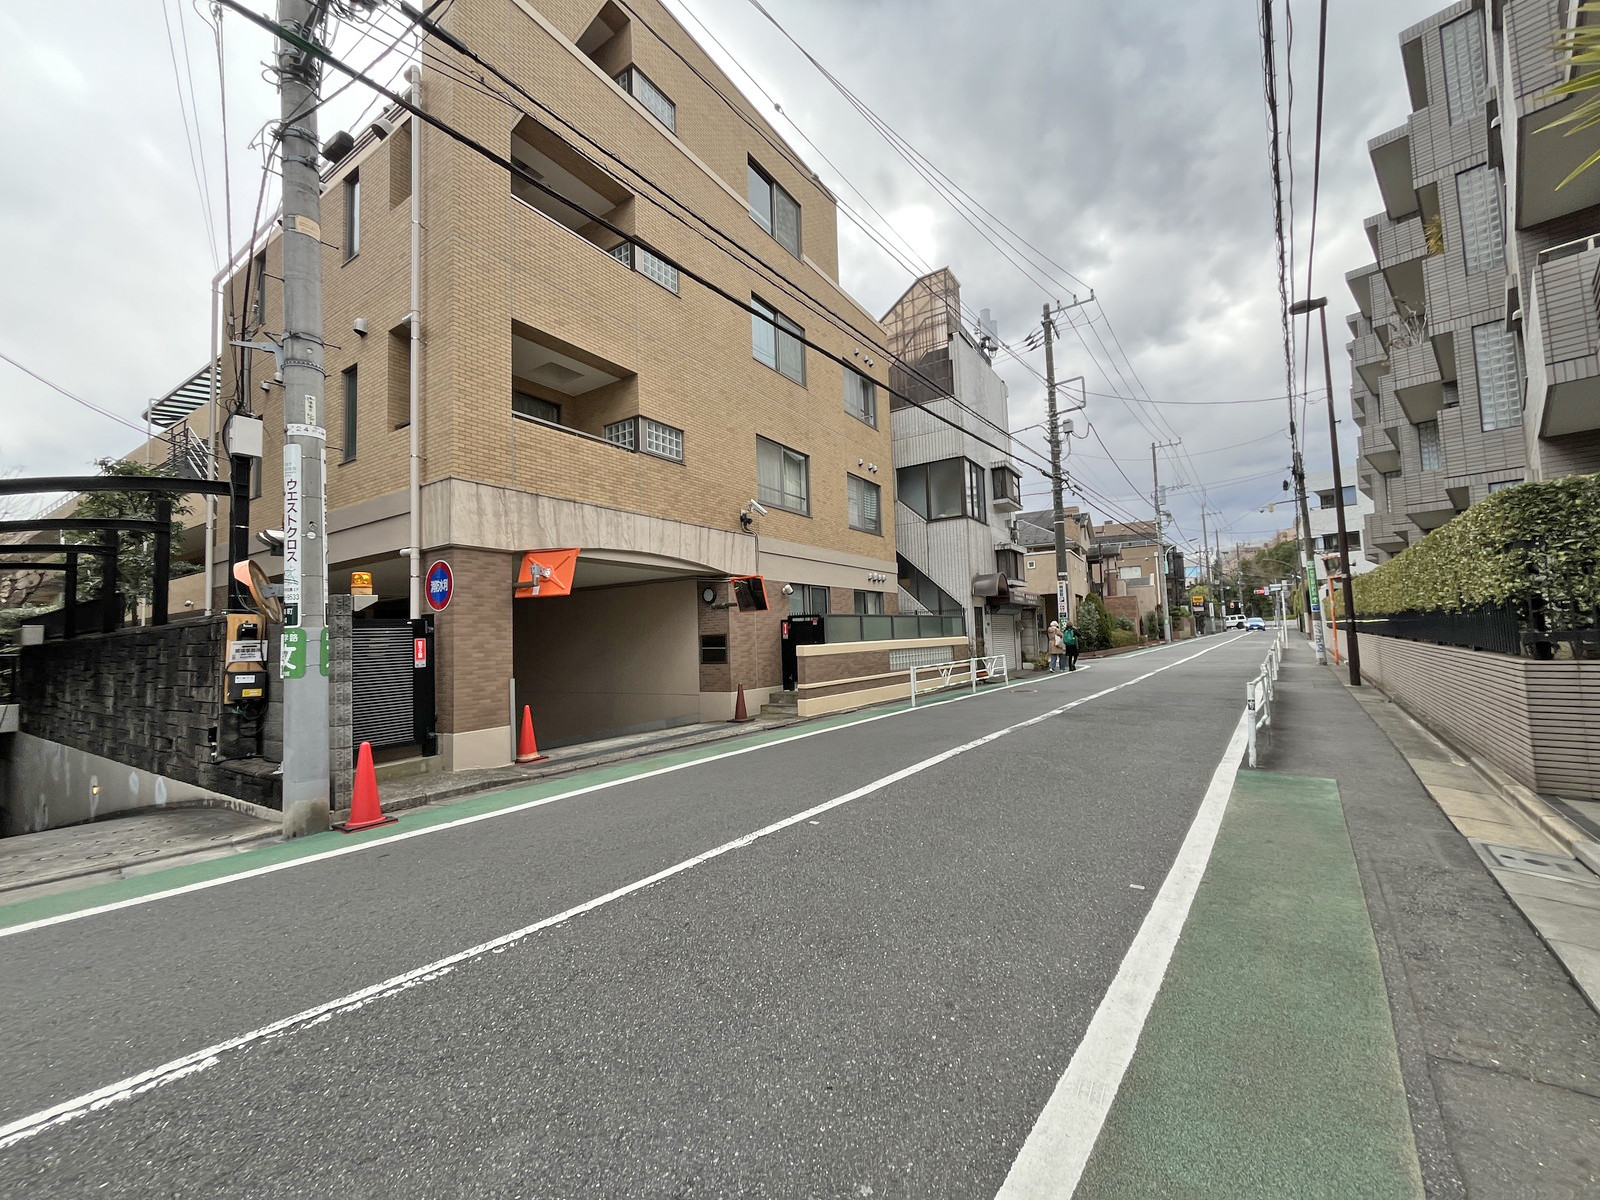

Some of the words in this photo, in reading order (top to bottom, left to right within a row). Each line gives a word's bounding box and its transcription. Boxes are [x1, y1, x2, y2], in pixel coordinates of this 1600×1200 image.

[287, 479, 298, 562] ウエストクロス
